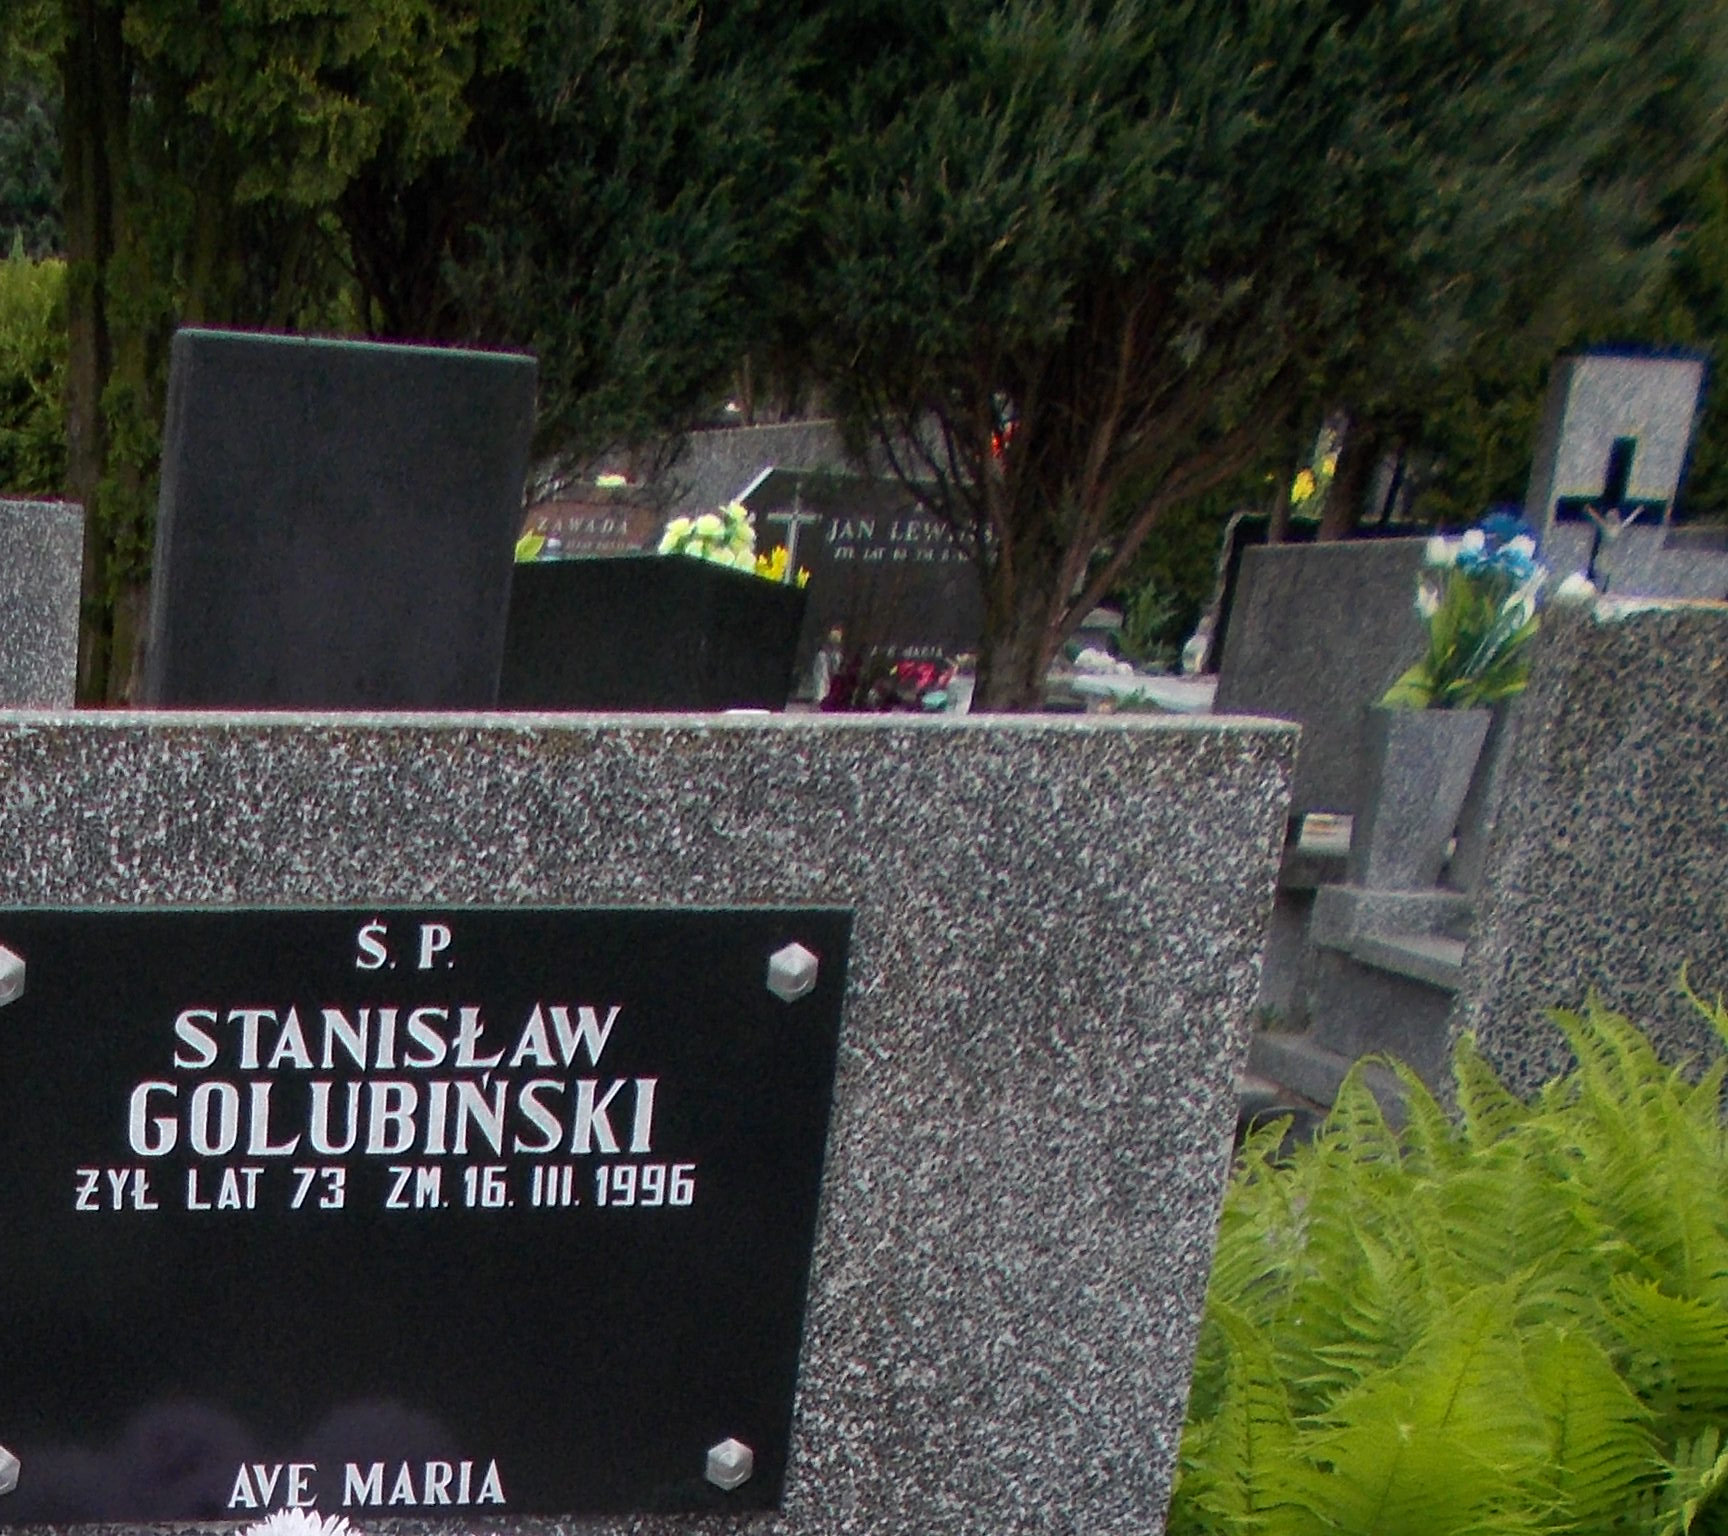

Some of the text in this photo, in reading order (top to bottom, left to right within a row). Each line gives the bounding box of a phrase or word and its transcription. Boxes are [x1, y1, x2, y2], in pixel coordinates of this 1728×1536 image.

[826, 518, 875, 544] JAN
[418, 924, 454, 969] P.
[174, 1002, 621, 1071] STANISŁAW
[128, 1070, 659, 1157] GOLUBIŃSKI
[76, 1167, 159, 1211] ŻYŁ
[188, 1167, 265, 1211] LAT
[291, 1166, 347, 1210] 73
[385, 1165, 449, 1209] ZM.
[464, 1165, 514, 1208] 16.
[596, 1163, 697, 1207] 1996
[227, 1458, 507, 1508] AVE MARIA
